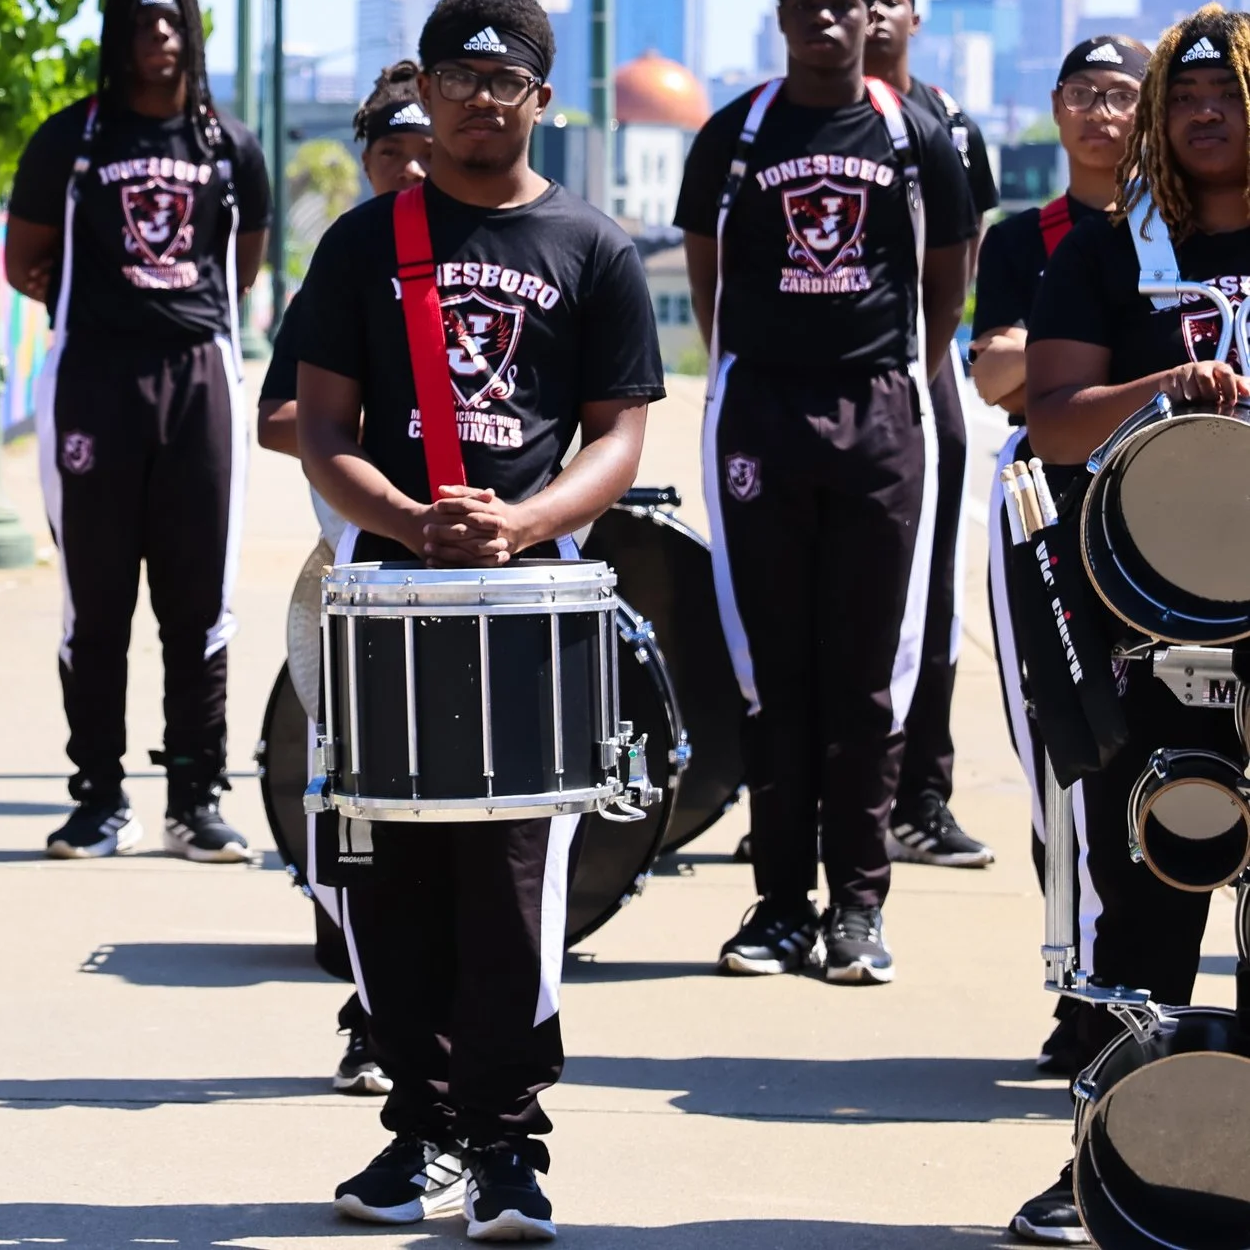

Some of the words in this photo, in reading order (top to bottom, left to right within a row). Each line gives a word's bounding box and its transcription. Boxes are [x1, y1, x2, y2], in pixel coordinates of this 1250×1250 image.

[464, 40, 507, 54] adidas
[1181, 48, 1221, 64] adidas
[389, 115, 431, 126] adidas
[755, 154, 894, 191] JONESBORO
[391, 262, 560, 311] JESBORO
[779, 276, 872, 294] CARDINALS
